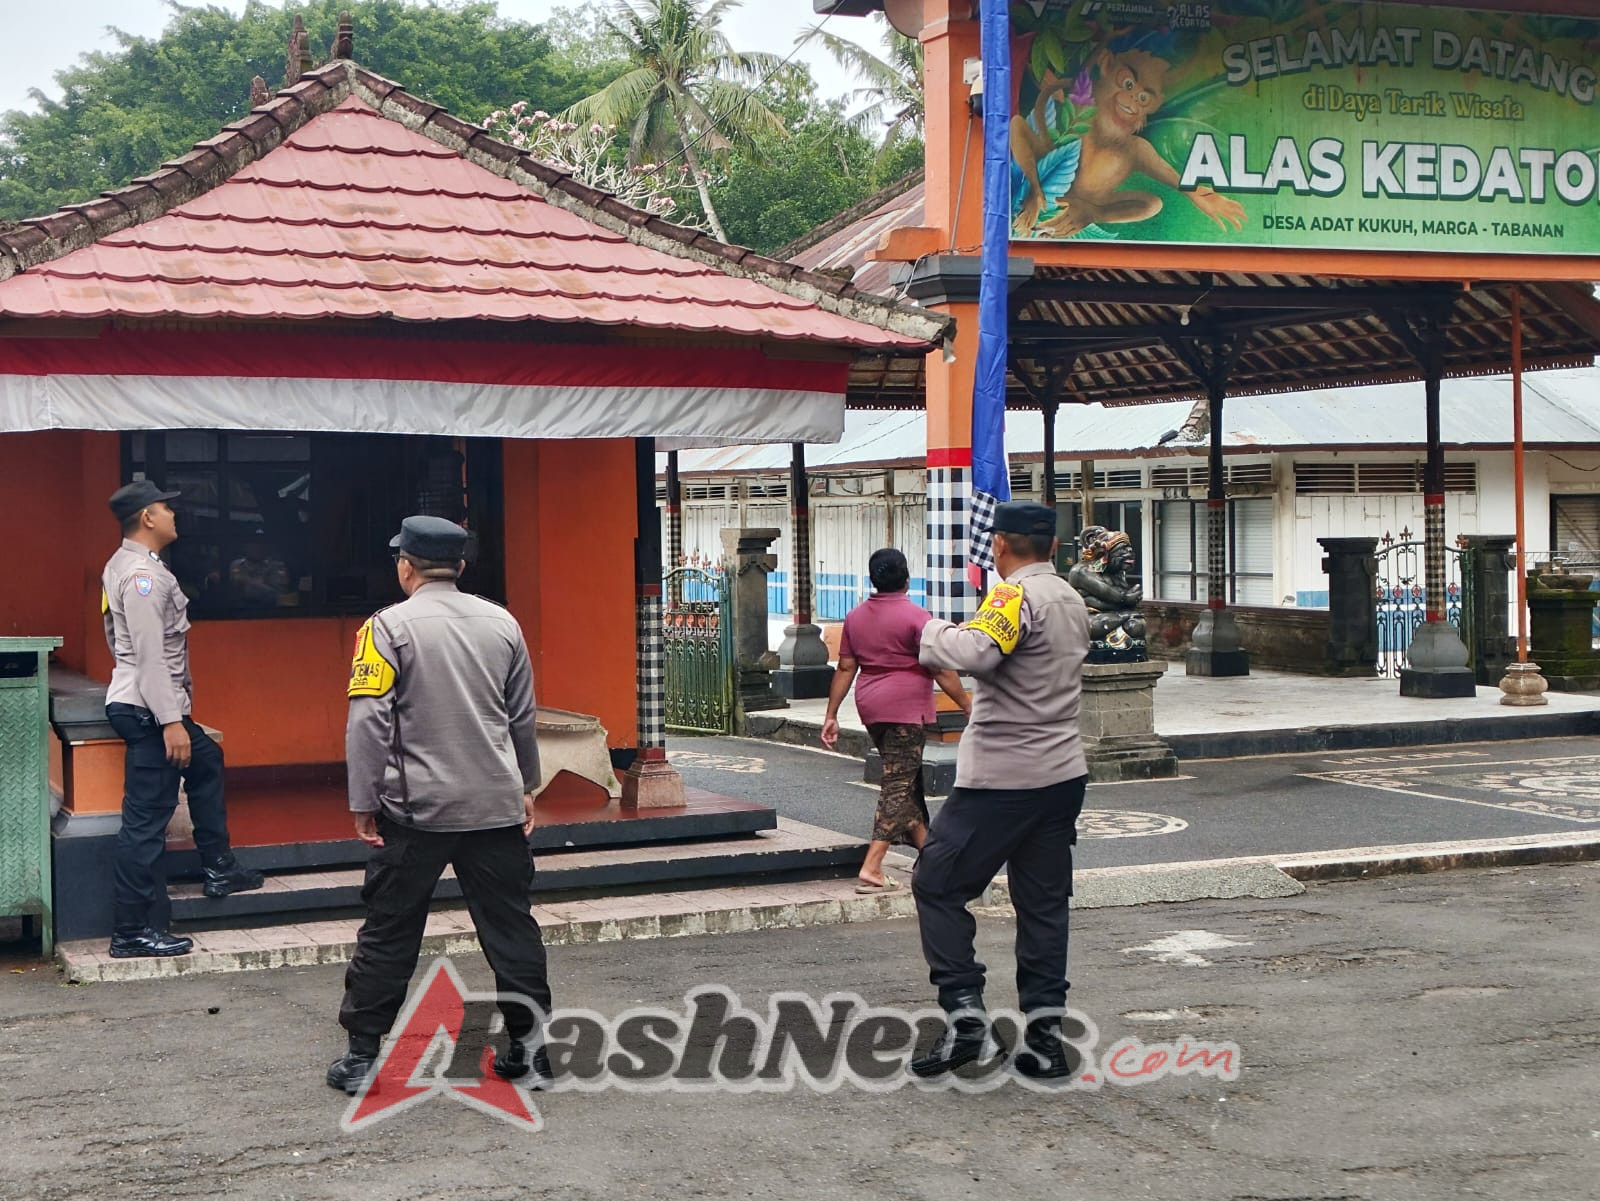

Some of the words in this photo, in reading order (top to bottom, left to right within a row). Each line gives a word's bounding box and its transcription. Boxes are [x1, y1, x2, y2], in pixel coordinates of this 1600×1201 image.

[1179, 3, 1210, 18] ALAS
[1222, 27, 1421, 87] SELAMAT
[1432, 29, 1596, 105] DATANG
[1303, 83, 1325, 111] di
[1328, 85, 1381, 121] Daya
[1384, 88, 1446, 117] Tarik
[1450, 91, 1524, 121] Wisata
[1178, 132, 1346, 198] ALAS
[1362, 140, 1600, 206] KEDATO
[1263, 214, 1306, 231] DESA
[1310, 216, 1354, 232] ADAT
[1358, 218, 1418, 236] KUKUH,
[1422, 220, 1478, 236] MARGA
[1491, 222, 1564, 238] TABANAN
